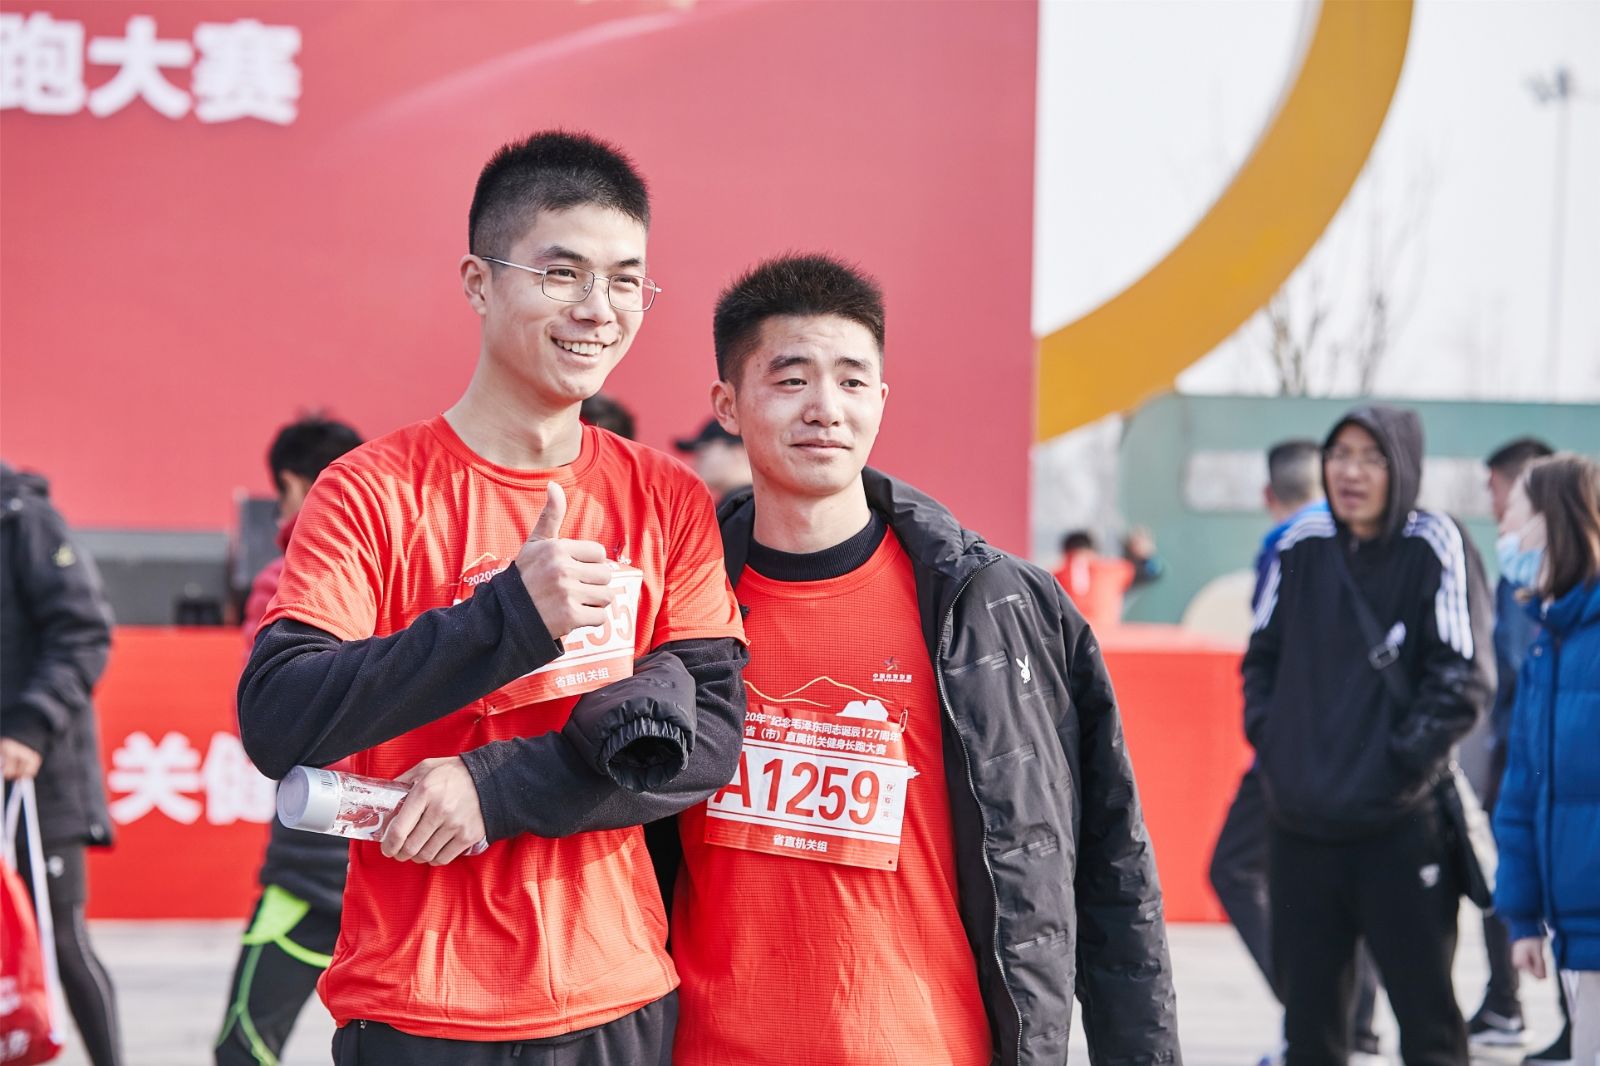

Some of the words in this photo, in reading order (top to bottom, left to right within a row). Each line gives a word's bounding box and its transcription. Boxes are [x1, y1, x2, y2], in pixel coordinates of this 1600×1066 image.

[0, 11, 302, 125] 跑大赛
[554, 667, 610, 689] 省直机关组
[713, 751, 880, 826] A1259
[772, 834, 828, 853] 省直机关组
